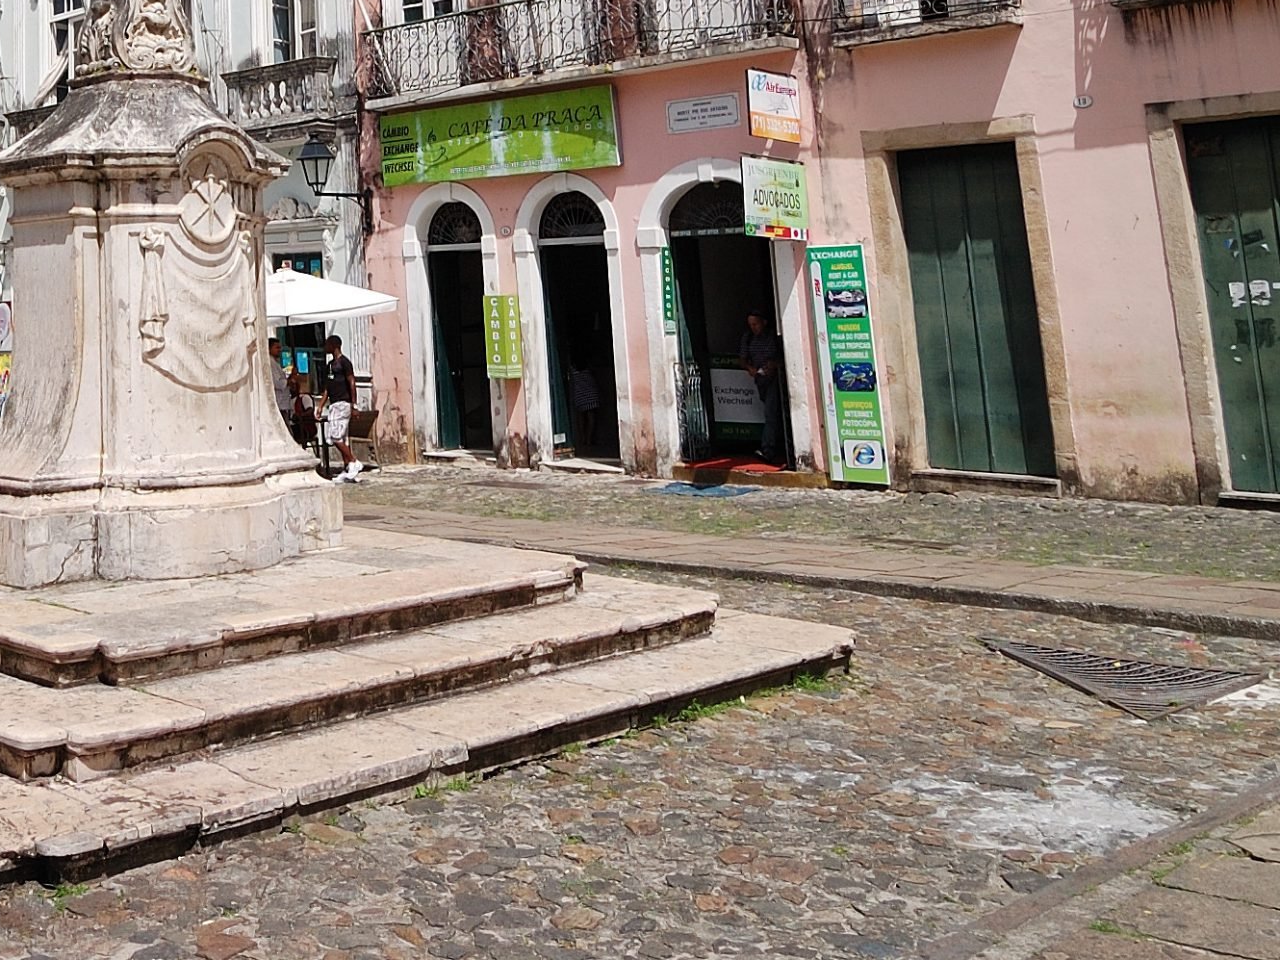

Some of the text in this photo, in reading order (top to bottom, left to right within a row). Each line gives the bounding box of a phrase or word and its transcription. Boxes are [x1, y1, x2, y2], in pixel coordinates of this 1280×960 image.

[448, 103, 604, 139] CAFÉ DA PRAÇA
[383, 143, 419, 156] EXCHANGE
[384, 161, 415, 174] WECHSEL
[753, 189, 801, 210] ADVOGADOS
[810, 250, 859, 260] EXCHANGE
[715, 386, 754, 396] Exchange
[718, 397, 753, 405] Wechsel
